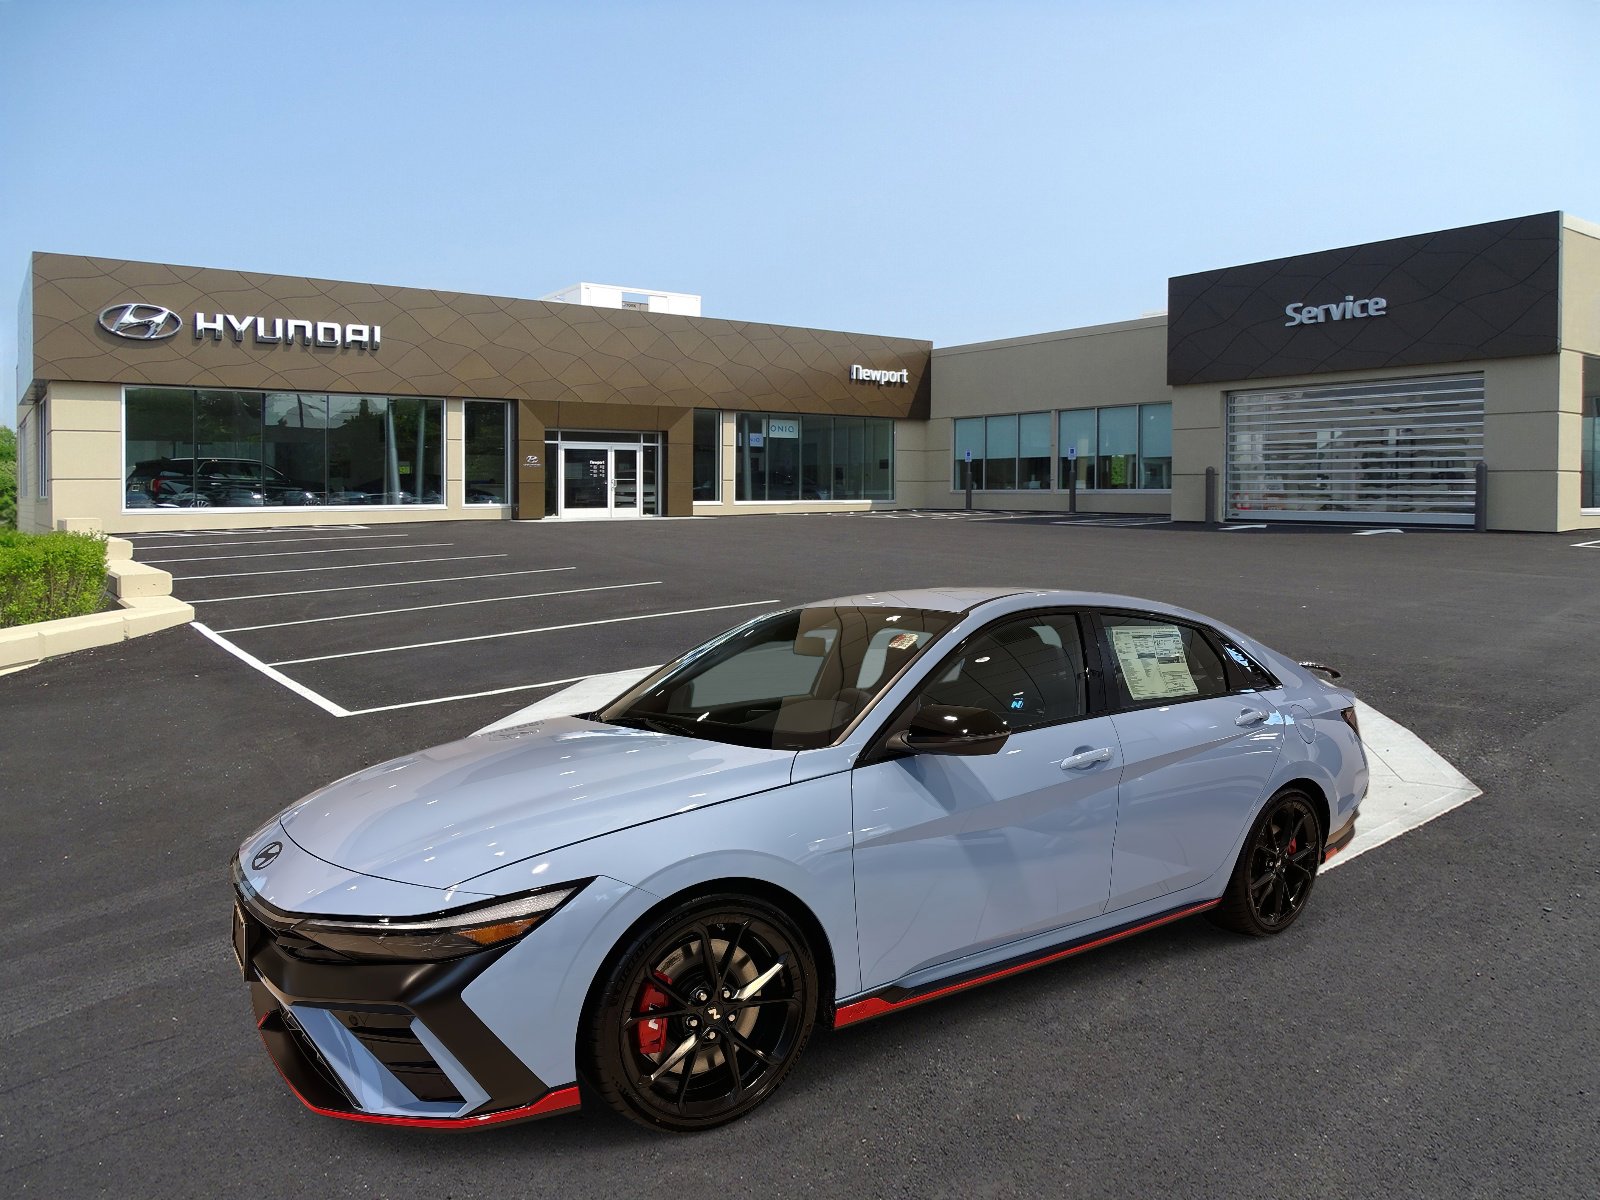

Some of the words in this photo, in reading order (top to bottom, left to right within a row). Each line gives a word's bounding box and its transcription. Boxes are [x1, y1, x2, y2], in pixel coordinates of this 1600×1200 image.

[1284, 295, 1387, 327] Service
[194, 311, 382, 350] HYUNDAI
[850, 364, 909, 385] Newport
[770, 424, 795, 433] ONIQ
